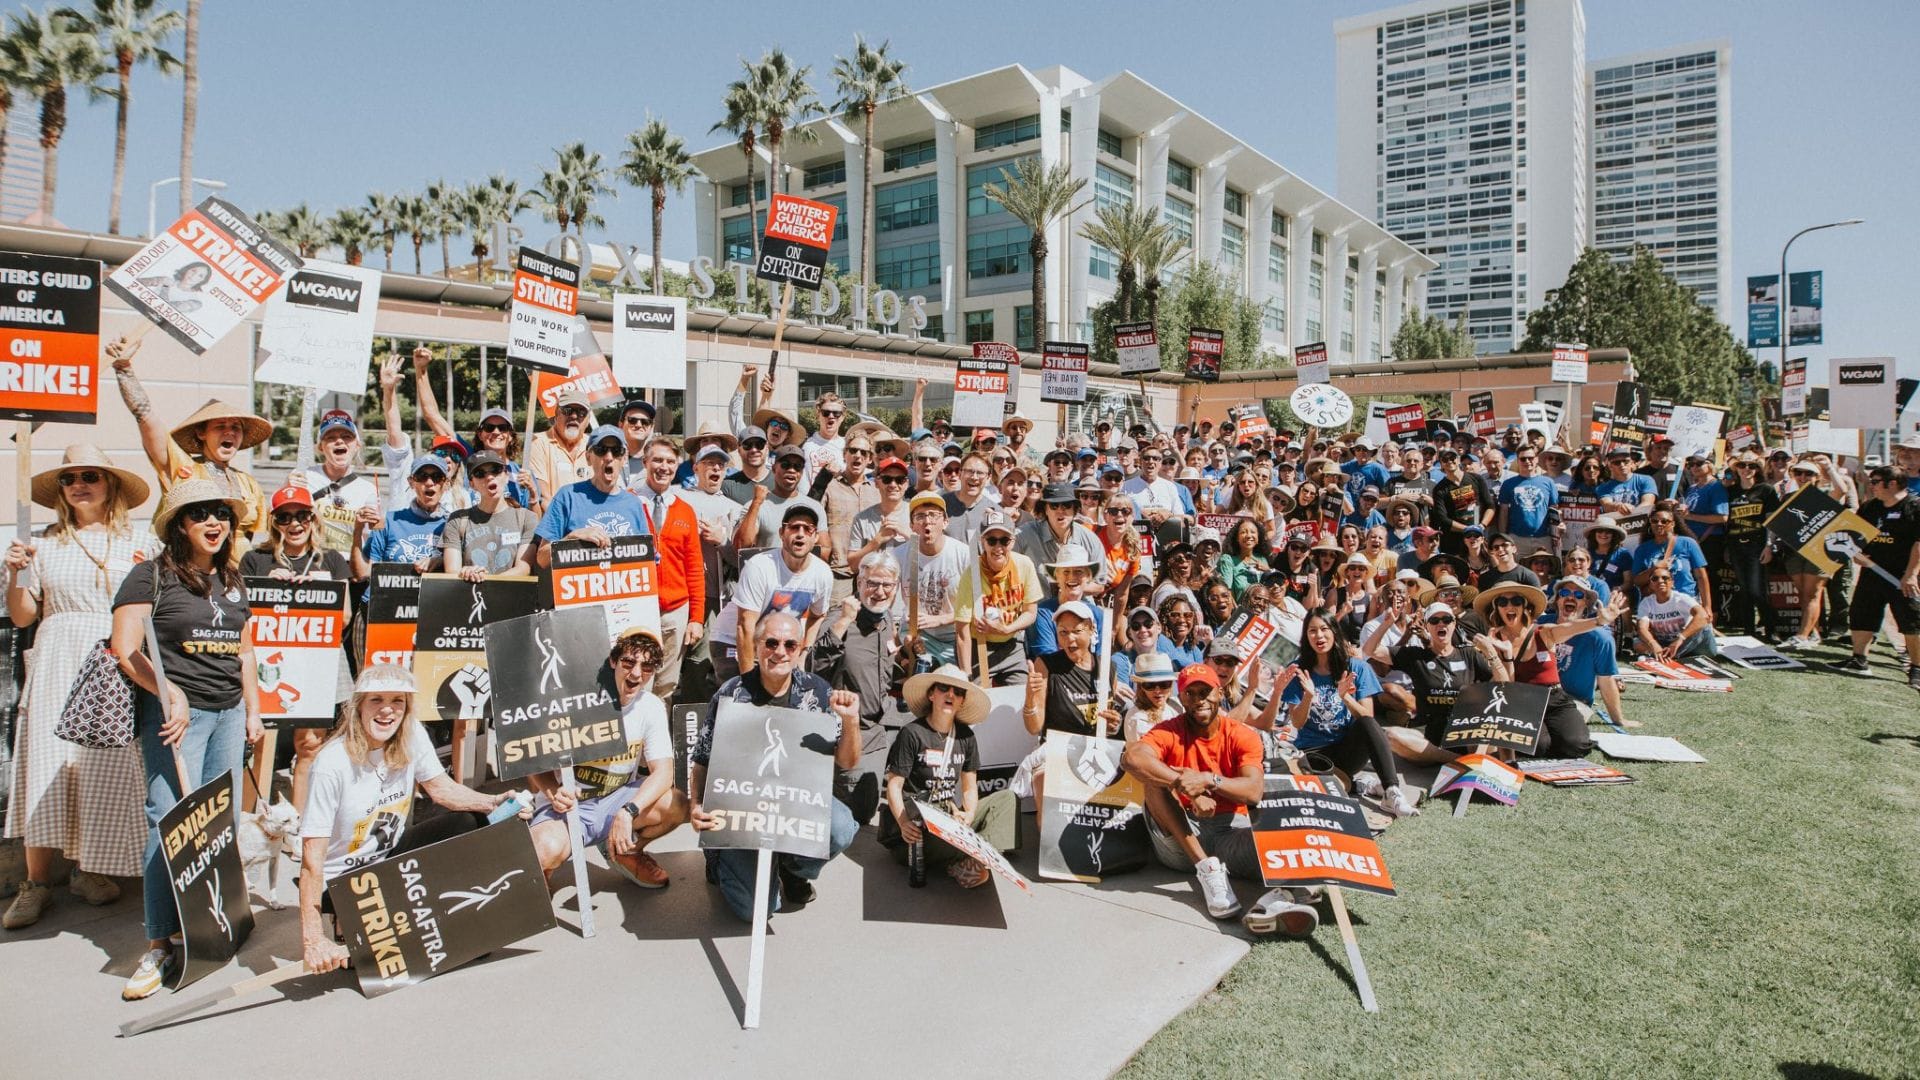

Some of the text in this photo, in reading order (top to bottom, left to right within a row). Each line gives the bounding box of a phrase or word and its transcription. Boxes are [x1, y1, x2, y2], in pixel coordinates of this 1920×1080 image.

[776, 200, 830, 221] WRITERS
[776, 212, 826, 232] GUILD OF
[206, 202, 292, 270] WRITERS GUILD
[770, 221, 826, 244] AMERICA
[124, 240, 170, 278] FIND OUT
[178, 219, 276, 296] STRIKE!
[490, 219, 652, 292] FOX
[786, 246, 802, 260] ON
[522, 254, 576, 282] WRITERS GUILD
[761, 255, 821, 284] STRIKE
[0, 268, 92, 290] TERS GUILD
[1811, 276, 1820, 300] WORK
[16, 290, 37, 303] OF
[290, 280, 358, 302] WGAW
[517, 277, 573, 312] STRIKE!
[0, 306, 66, 326] MERICA
[154, 302, 200, 338] AROUND
[516, 312, 569, 334] OUR WORK
[627, 310, 673, 324] WGAW
[10, 338, 42, 358] ON
[514, 338, 567, 358] YOUR PROFITS
[1118, 334, 1154, 347] STRIKE!
[1190, 340, 1221, 353] STRIKE!
[960, 360, 1006, 370] WRITERS GUILD
[1044, 356, 1085, 370] STRIKE!
[1297, 352, 1326, 366] STRIKE!
[0, 362, 90, 396] RIKE!
[958, 375, 1005, 390] STRIKE!
[1061, 374, 1078, 383] DAYS
[1841, 370, 1882, 379] WGAW
[1388, 409, 1422, 425] STRIKE!
[323, 507, 356, 522] STRI
[594, 511, 615, 521] GUILD
[1564, 509, 1596, 520] RIKE!
[1800, 510, 1837, 543] ON STRIKE!
[558, 543, 648, 563] WRITERS GUILD
[599, 561, 611, 570] ON
[378, 575, 421, 588] WRITE
[560, 567, 650, 600] STRIKE!
[247, 587, 338, 604] RITERS GUILD
[274, 604, 288, 614] ON
[248, 615, 336, 644] TRIKE!
[1230, 613, 1249, 633] GUILD
[182, 640, 242, 655] STRON
[434, 638, 457, 648] ON
[1186, 666, 1206, 675] KC
[1427, 696, 1456, 705] STRO
[548, 716, 572, 731] ON
[686, 711, 698, 746] GUILD
[504, 721, 621, 764] STRIKE!
[1446, 728, 1533, 746] STRIKE!
[578, 768, 622, 786] ON STRIKE
[757, 801, 780, 813] ON
[1058, 802, 1110, 818] STRIKE!
[1257, 798, 1356, 814] WRITERS GUILD
[168, 788, 232, 860] STRIKE!
[709, 809, 826, 842] STRIKE!
[1280, 818, 1344, 831] AMERICA
[193, 833, 209, 850] ON
[1305, 834, 1332, 847] ON
[344, 857, 365, 866] ON
[1265, 848, 1382, 877] STRIKE!
[350, 872, 410, 988] STRIKE!
[393, 910, 412, 936] ON
